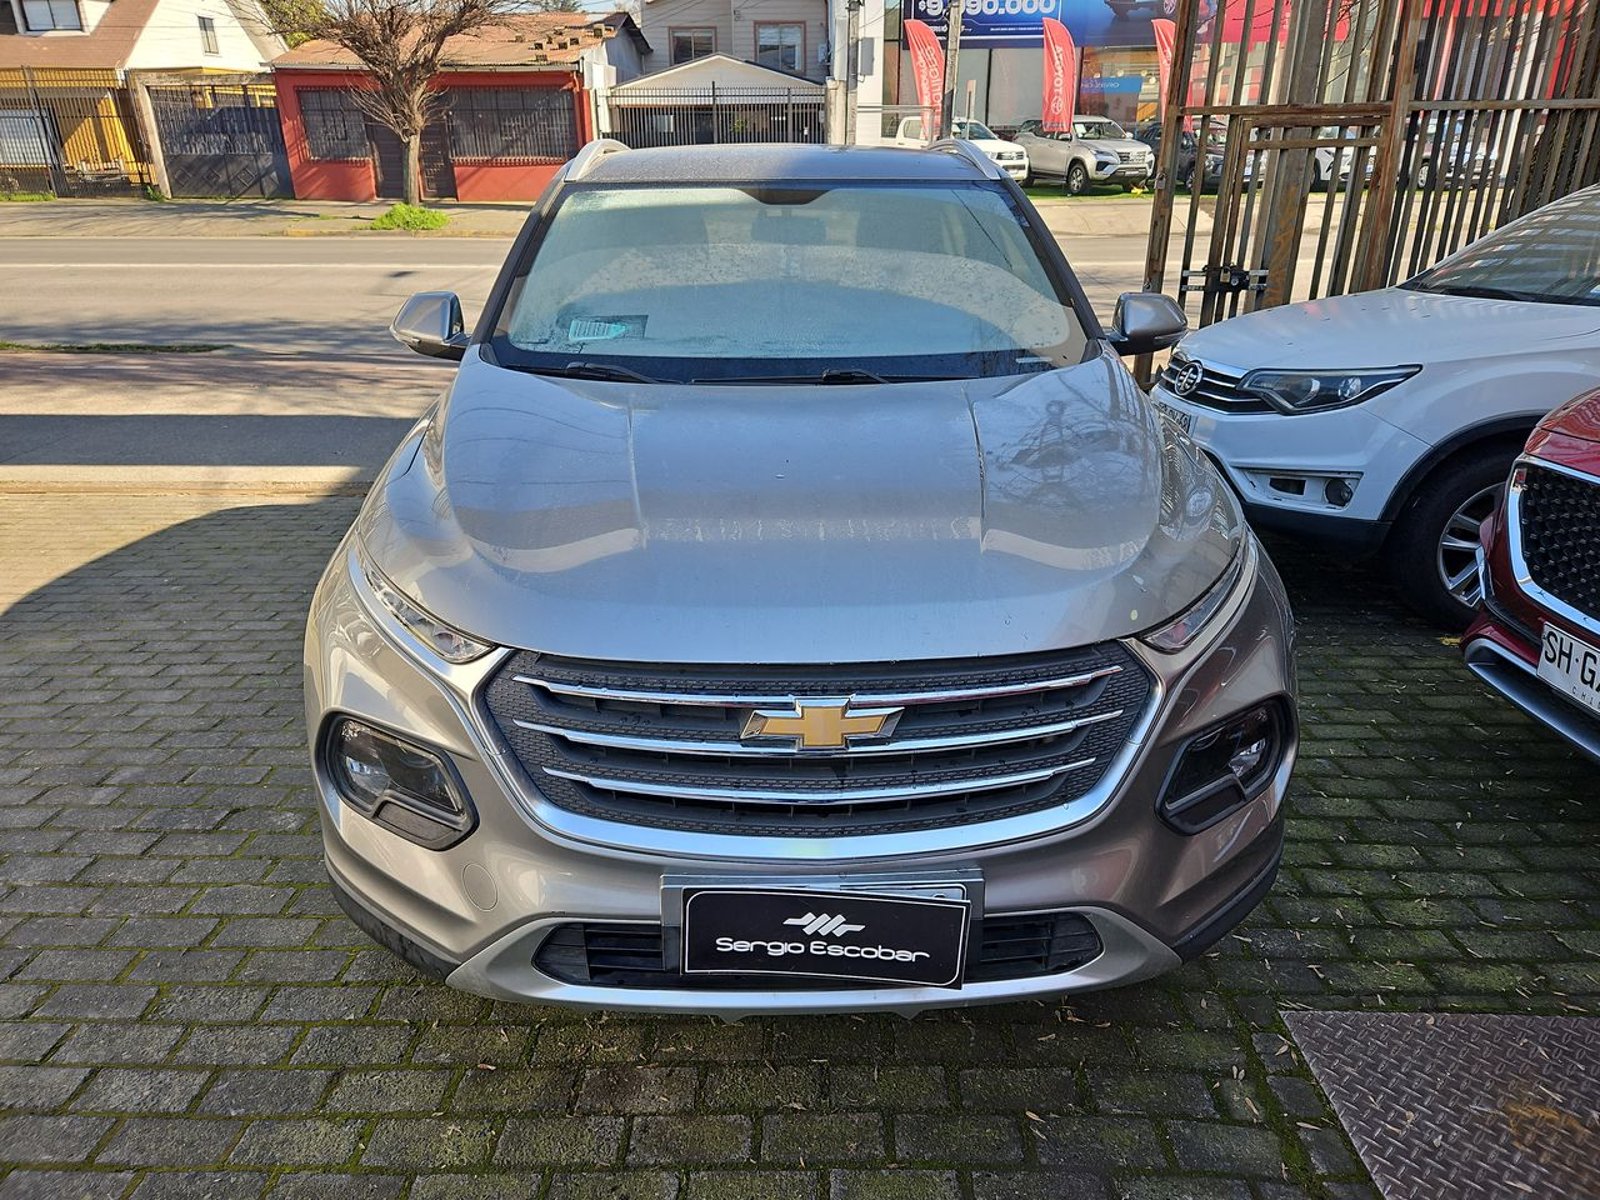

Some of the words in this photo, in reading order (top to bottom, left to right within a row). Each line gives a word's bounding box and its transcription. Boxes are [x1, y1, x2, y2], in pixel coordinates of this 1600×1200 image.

[1544, 630, 1600, 692] SH·G
[716, 937, 805, 956] Sergio
[809, 941, 931, 962] Escobar
